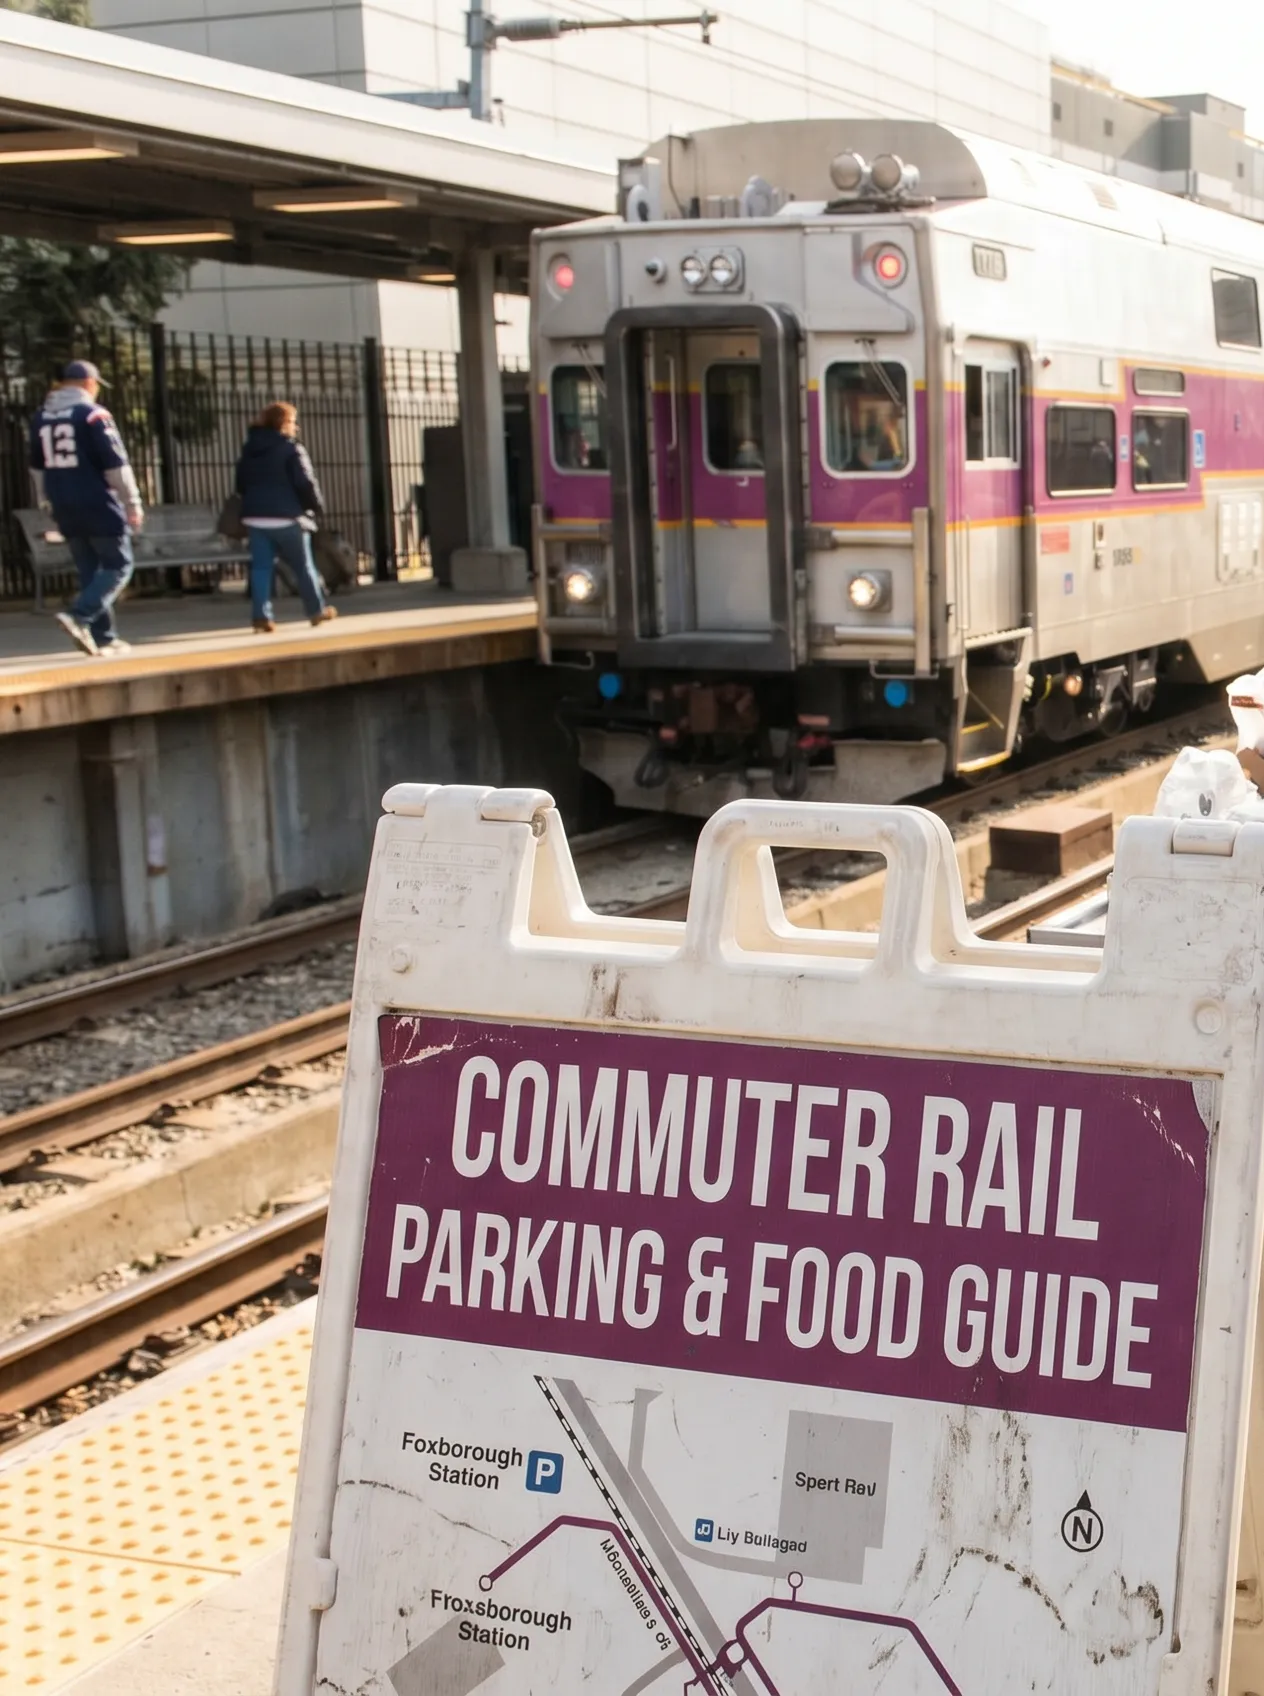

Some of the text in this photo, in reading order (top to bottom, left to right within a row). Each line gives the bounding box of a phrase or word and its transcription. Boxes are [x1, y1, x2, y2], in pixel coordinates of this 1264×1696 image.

[450, 1055, 1100, 1241] COMMUTER RAIL
[385, 1203, 1159, 1389] PARKING & FOOD GUIDE
[401, 1431, 523, 1469] Foxborough
[428, 1462, 500, 1491] Station
[535, 1457, 556, 1487] P
[795, 1471, 840, 1493] Spert
[1071, 1515, 1093, 1545] N
[430, 1589, 573, 1632] Froxsborough
[457, 1620, 531, 1651] Station
